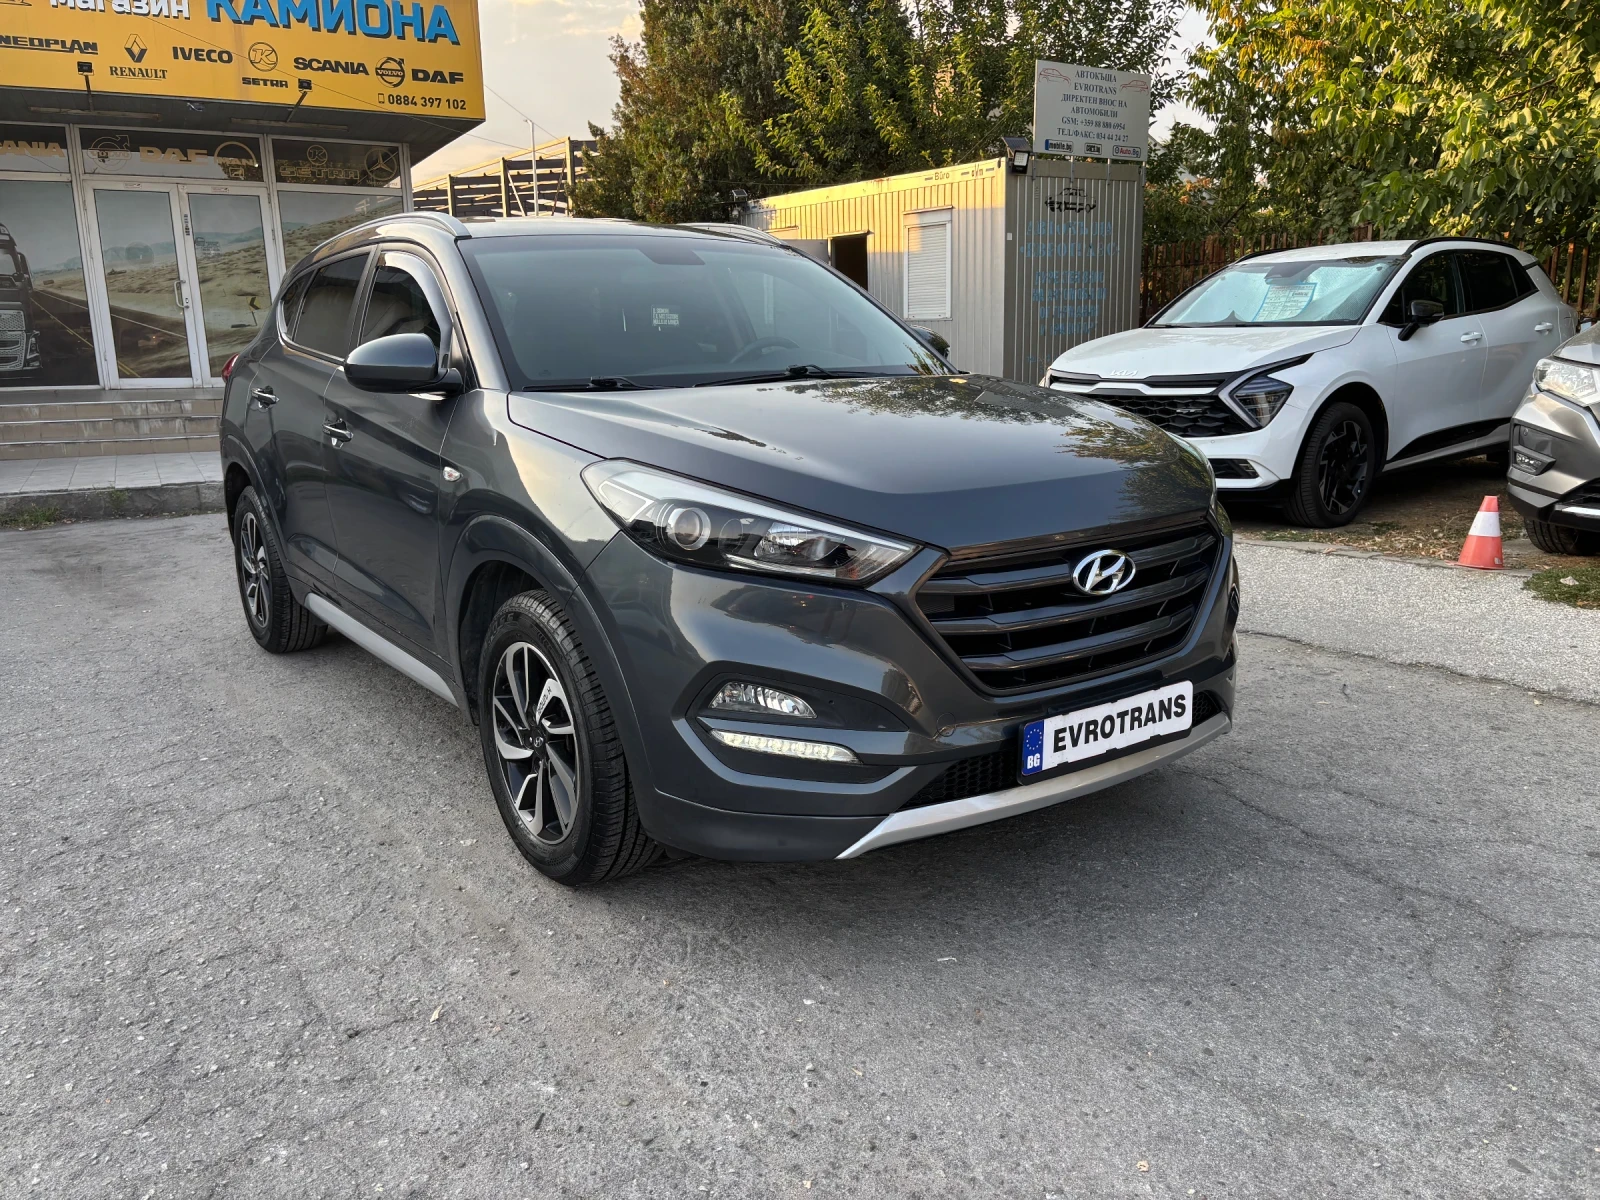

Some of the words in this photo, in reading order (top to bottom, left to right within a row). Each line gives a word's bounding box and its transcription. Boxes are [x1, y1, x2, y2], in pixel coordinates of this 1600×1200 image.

[0, 34, 98, 54] NEOPLAN
[172, 46, 233, 64] IVECO
[109, 66, 168, 80] RENAULT
[293, 57, 369, 76] SCANIA
[376, 69, 404, 77] VOLVO
[242, 77, 288, 89] SETRA
[411, 69, 464, 84] DAF
[1074, 70, 1117, 82] АВТОКЪЩА
[1074, 82, 1117, 95] EVROTRANS
[388, 94, 417, 107] 0884
[421, 96, 441, 108] 397
[446, 98, 467, 110] 102
[1061, 94, 1098, 105] ДИРЕКТЕН
[1098, 98, 1117, 107] ВНОС
[1118, 100, 1128, 108] НА
[1071, 106, 1118, 118] АВТОМОБИЛИ
[1062, 116, 1079, 126] GSM:
[1080, 119, 1094, 127] +359
[1107, 133, 1114, 141] 44
[0, 140, 66, 158] ANIA
[139, 146, 209, 164] DAF
[217, 156, 255, 166] MAN
[280, 165, 360, 180] SETRA
[1053, 694, 1186, 753] EVROTRANS
[1027, 753, 1041, 769] BG
